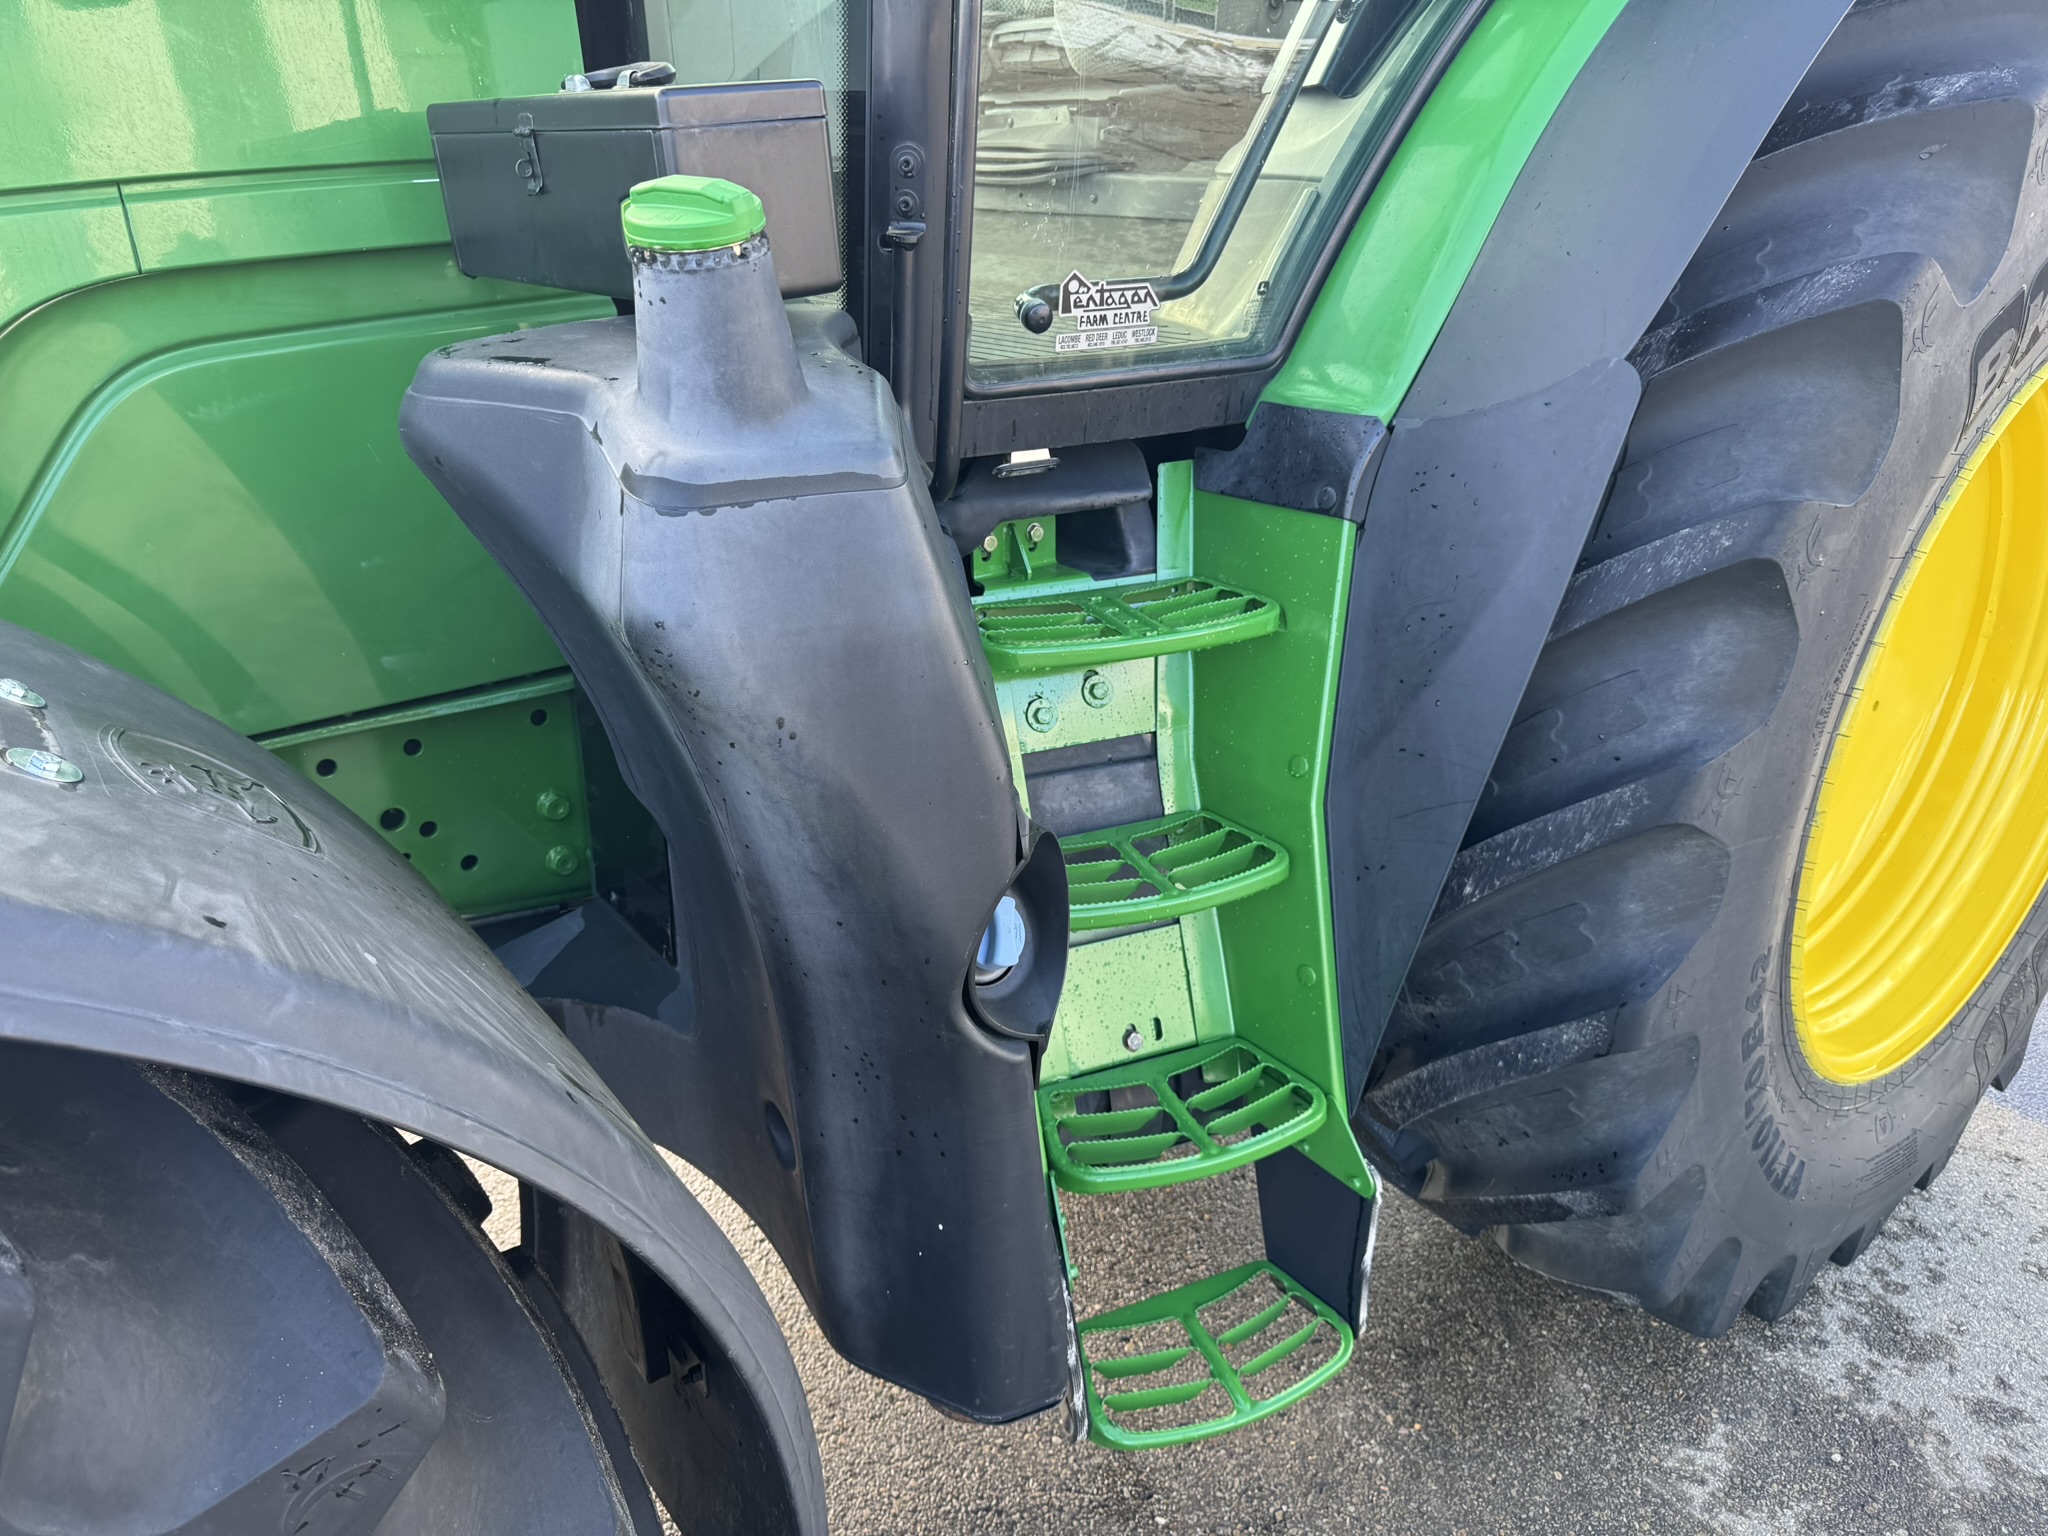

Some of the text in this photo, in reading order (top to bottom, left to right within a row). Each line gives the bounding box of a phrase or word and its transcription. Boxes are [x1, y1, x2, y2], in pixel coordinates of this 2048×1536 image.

[1079, 310, 1149, 328] FARM CENTRE
[1058, 334, 1082, 345] LACOMBE
[1085, 333, 1095, 343] RED
[1095, 332, 1108, 342] DEER
[1112, 331, 1128, 340] LEDUC
[1132, 328, 1156, 338] WESTLOCK
